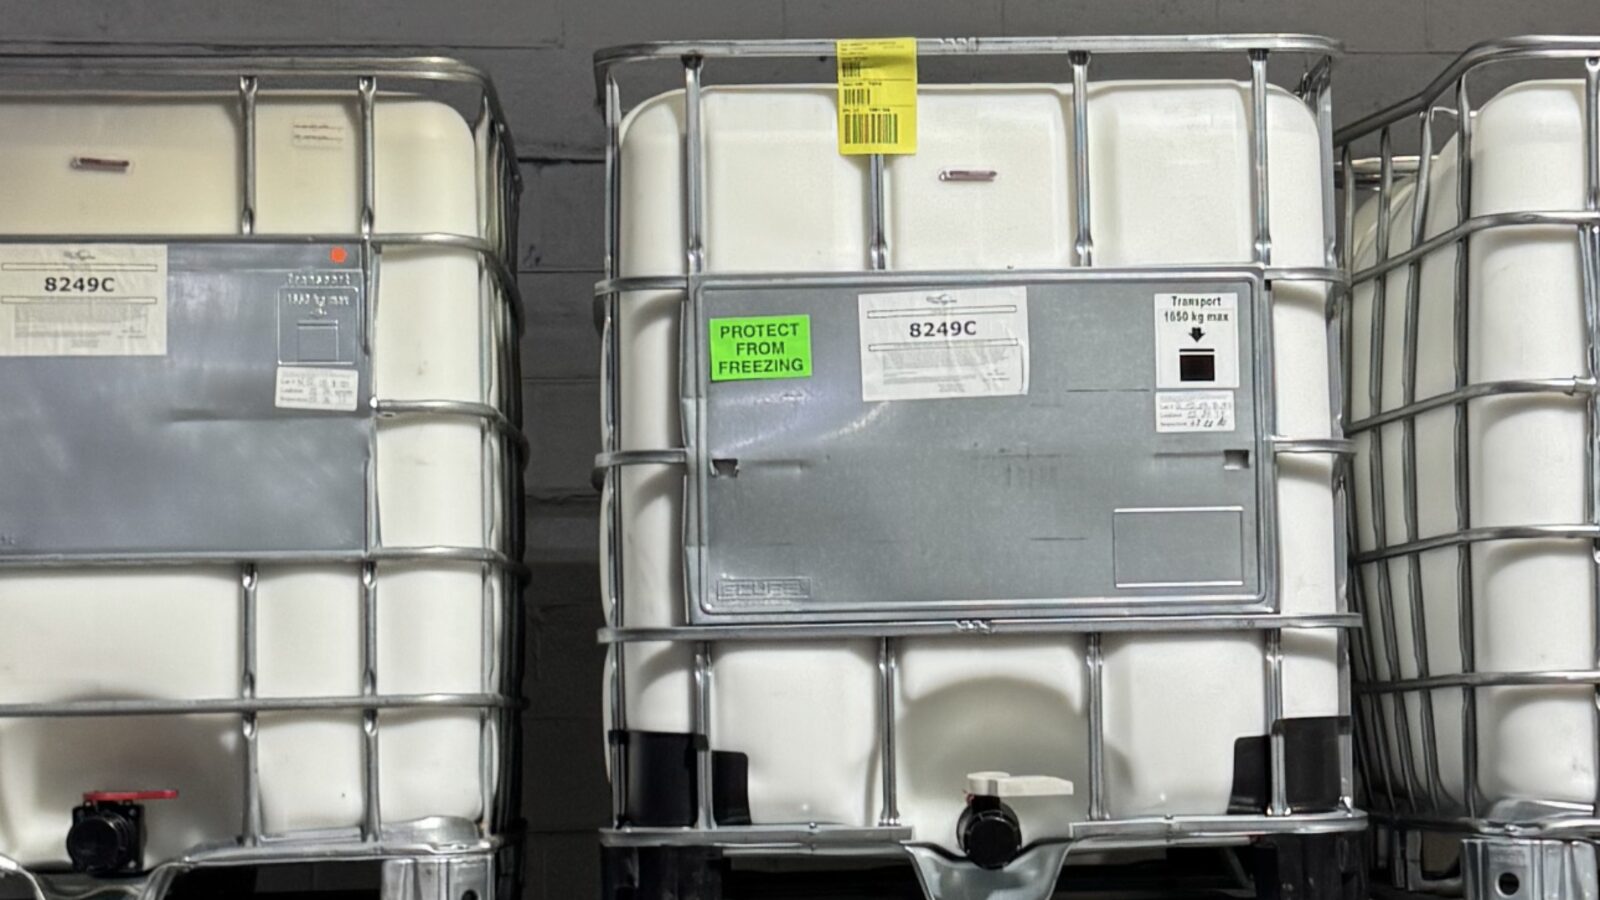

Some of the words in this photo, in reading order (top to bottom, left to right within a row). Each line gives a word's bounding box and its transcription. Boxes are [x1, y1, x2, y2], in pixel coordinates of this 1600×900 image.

[44, 276, 115, 293] 8249C
[1172, 295, 1222, 308] Transport
[1191, 311, 1204, 324] kg
[1207, 313, 1229, 321] max
[720, 323, 799, 339] PROTECT
[909, 320, 977, 338] 8249C
[736, 341, 785, 356] FROM
[718, 358, 804, 375] FREEZING
